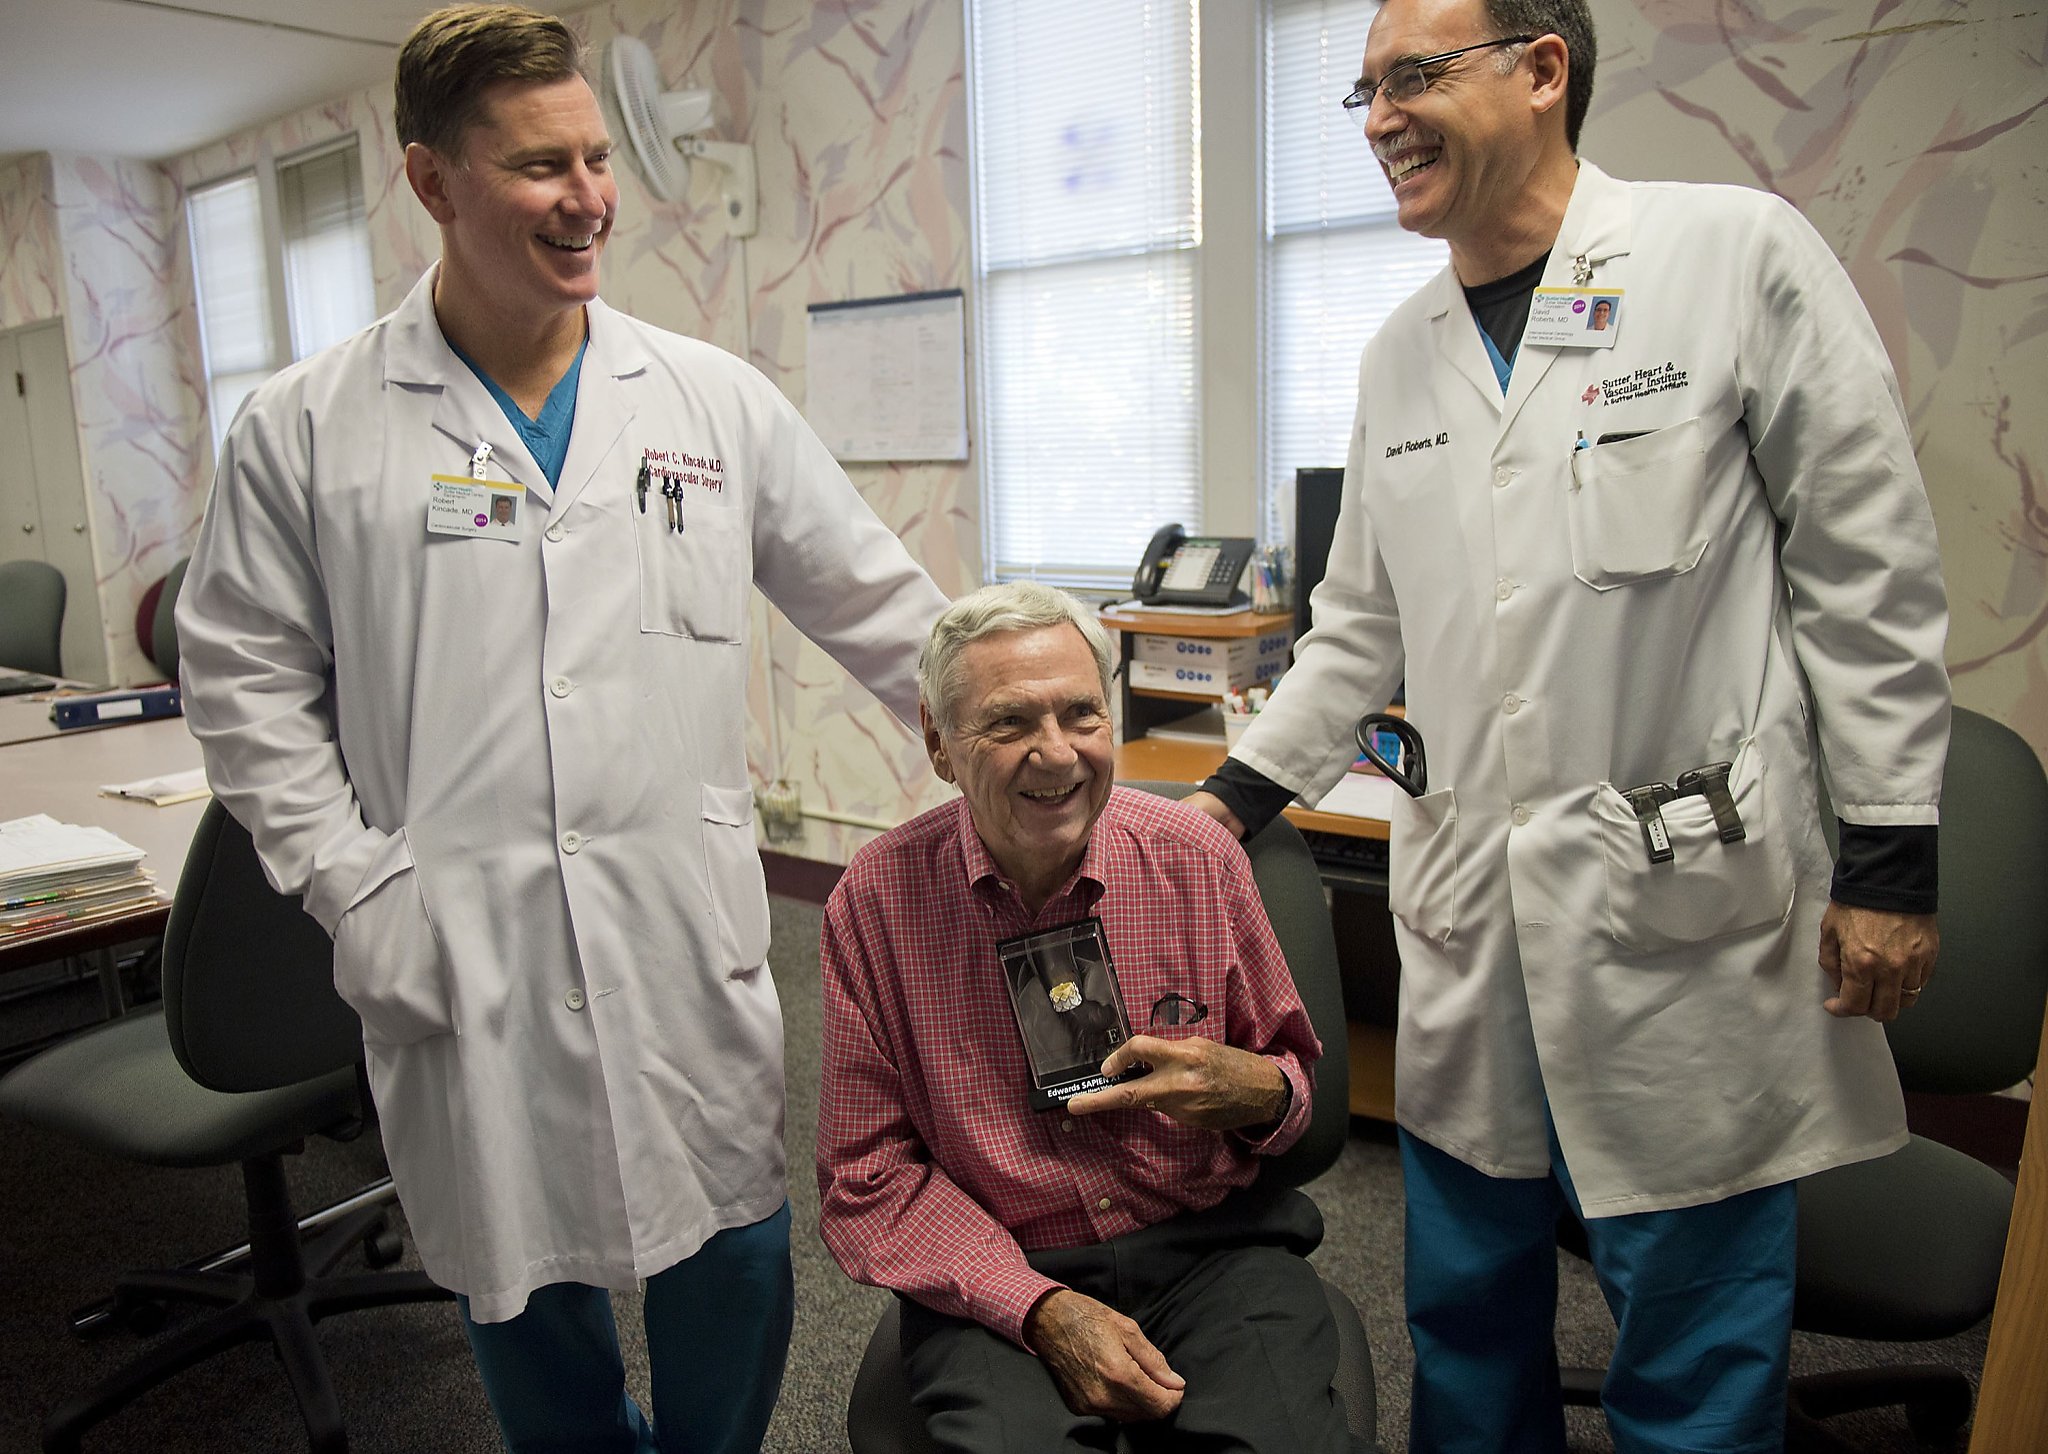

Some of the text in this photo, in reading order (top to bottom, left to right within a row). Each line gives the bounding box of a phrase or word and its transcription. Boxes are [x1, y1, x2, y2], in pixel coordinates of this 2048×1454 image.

[1602, 361, 1674, 389] Sutter Heart &
[1603, 370, 1687, 399] Vascular Institute
[1610, 394, 1633, 405] Sutter
[1634, 387, 1658, 398] Health
[1659, 380, 1689, 392] Affiliate
[1385, 431, 1450, 458] David Roberts, M.D.
[644, 447, 670, 463] Robert
[671, 451, 680, 465] C.
[708, 458, 724, 473] M.D.
[647, 463, 723, 493] Cardiovascular Surgery
[432, 496, 455, 505] Robert
[1107, 1027, 1120, 1044] E
[1047, 1083, 1080, 1098] Edwards
[1081, 1077, 1109, 1090] SAPIEN
